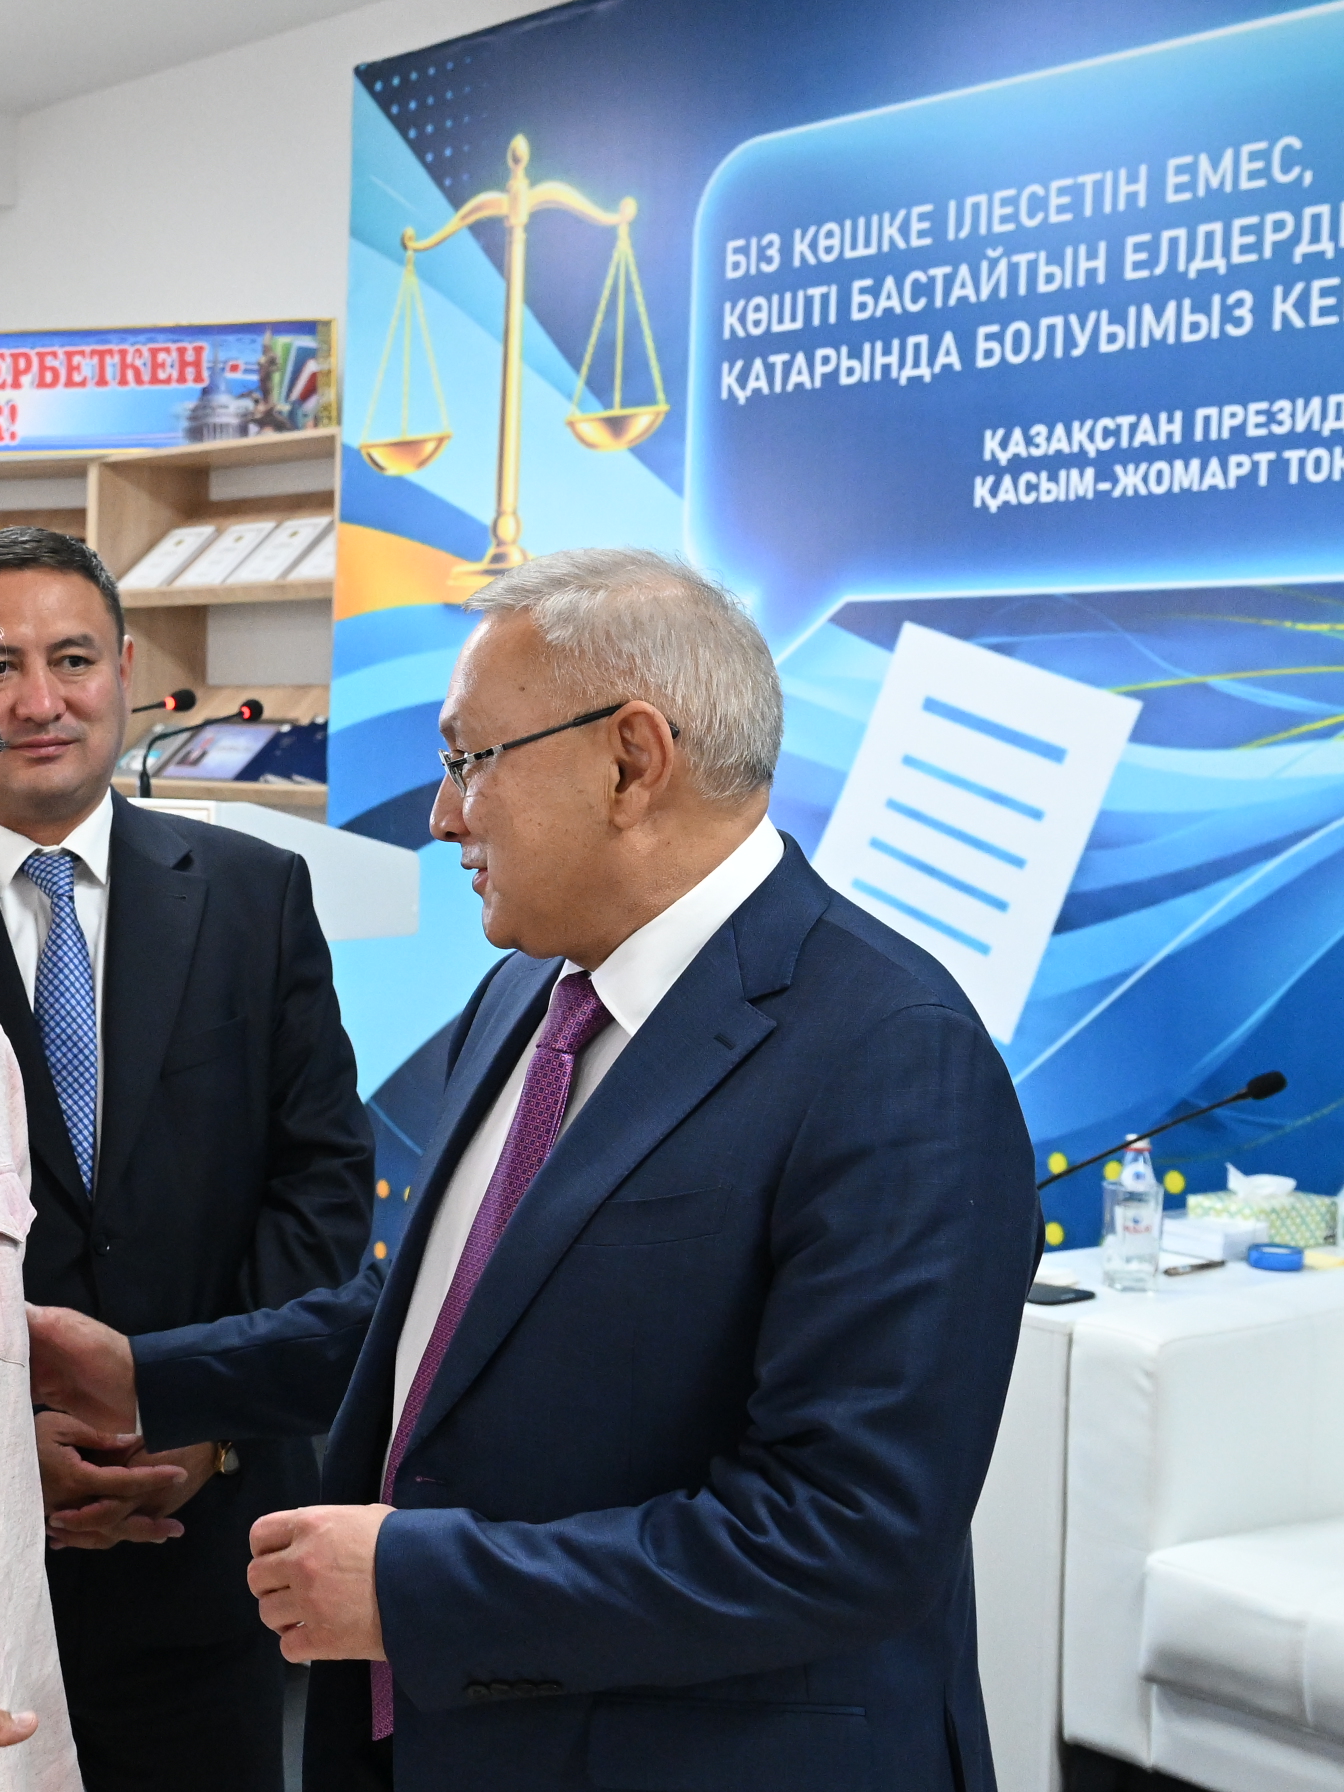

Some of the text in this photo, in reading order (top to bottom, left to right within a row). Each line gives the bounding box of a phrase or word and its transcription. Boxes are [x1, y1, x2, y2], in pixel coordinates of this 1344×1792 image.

[724, 136, 1314, 280] БІЗ КӨШКЕ ІЛЕСЕТІН ЕМЕС,
[722, 284, 838, 340] КӨШТІ
[850, 243, 1107, 322] БАСТАЙТЫН
[720, 332, 962, 405] ҚАТАРЫНДА
[975, 289, 1255, 369] БОЛУЫМЫЗ
[972, 450, 1277, 513] ҚАСЫМ-ЖОМАРТ
[982, 410, 1184, 466] ҚАЗАҚСТАН
